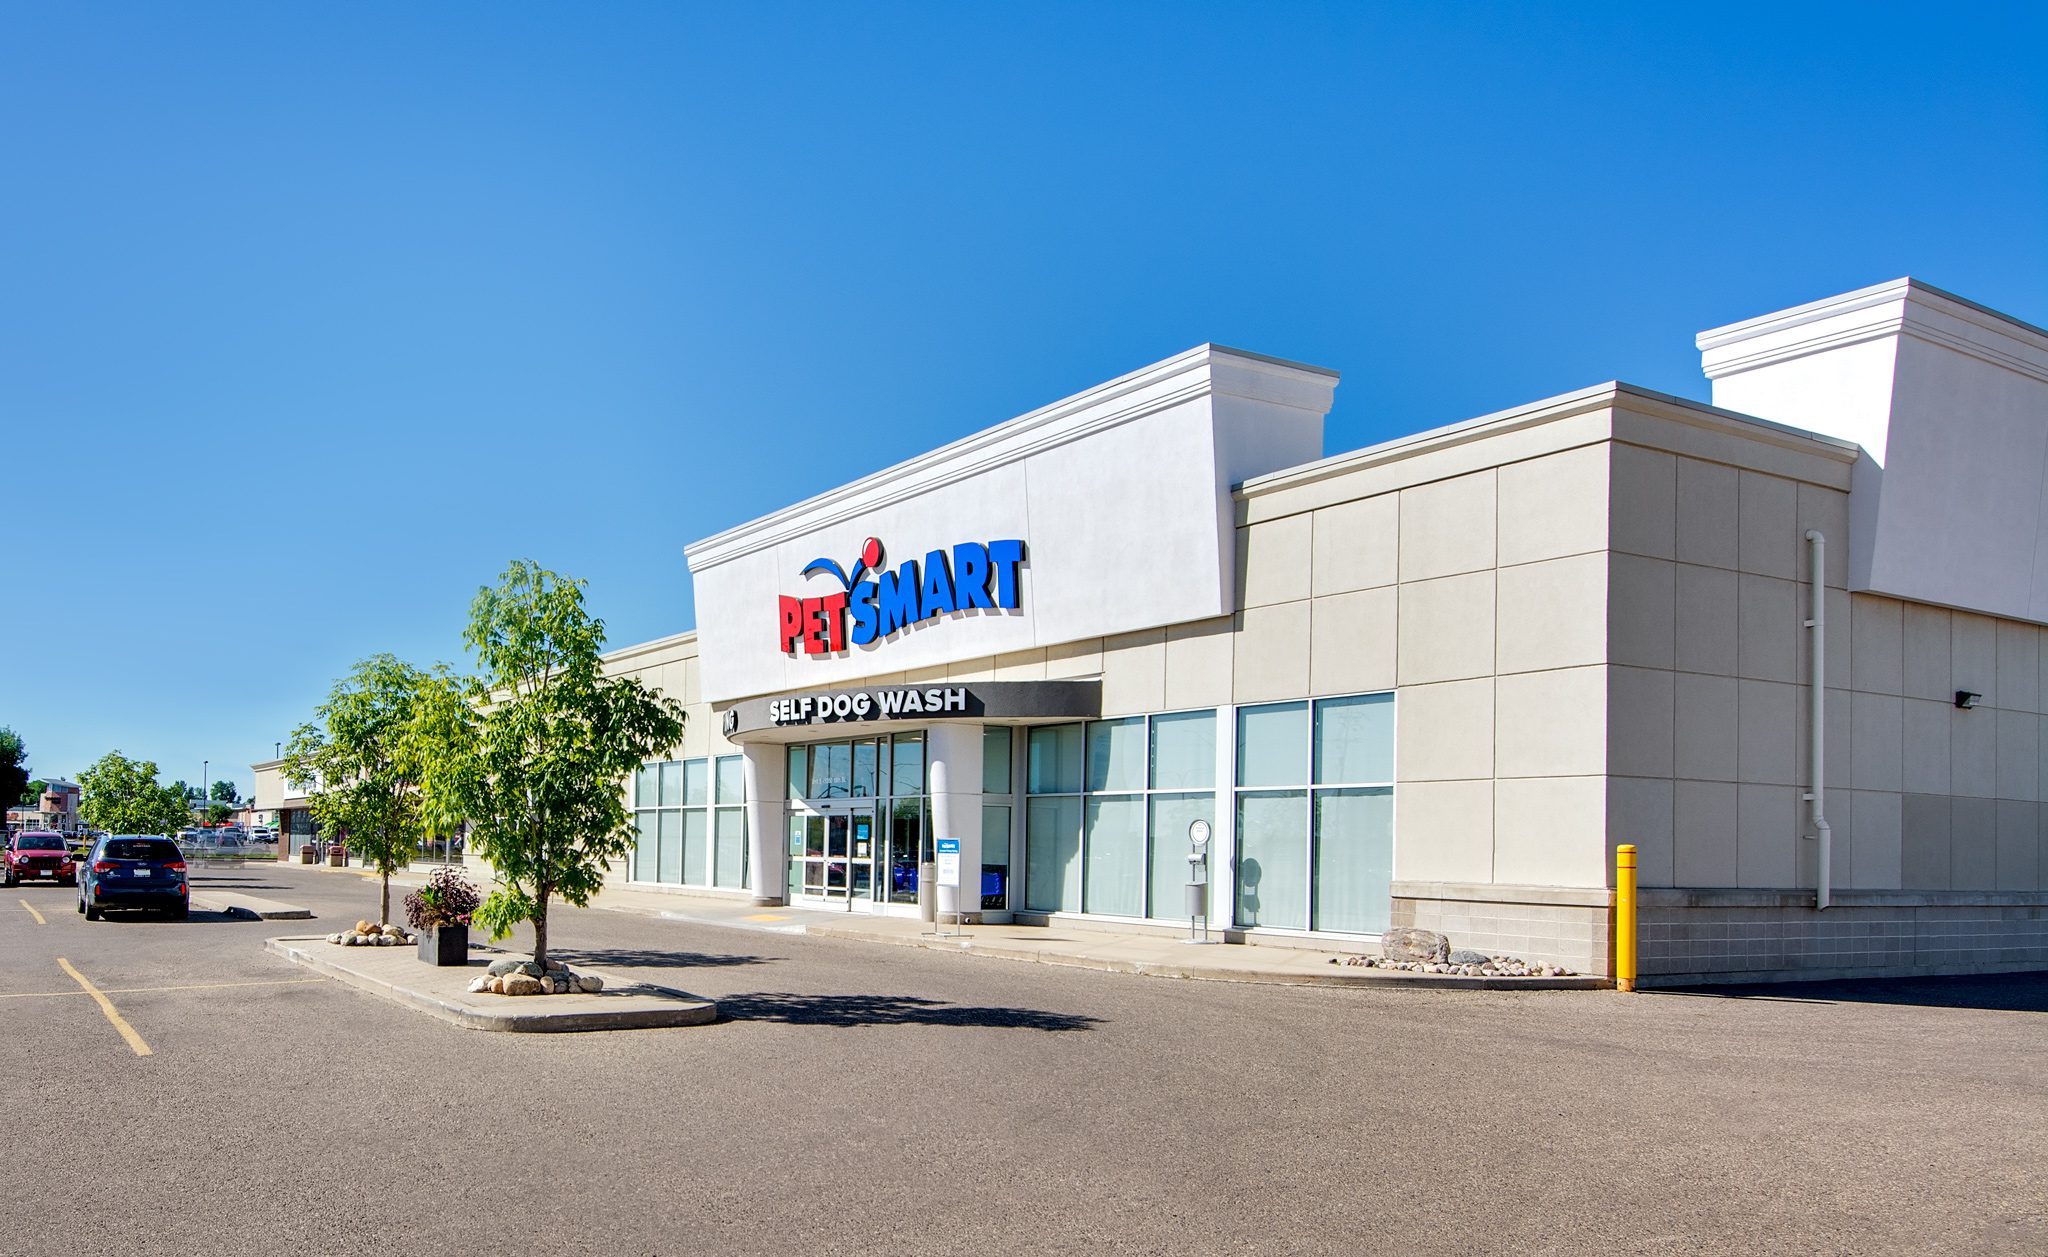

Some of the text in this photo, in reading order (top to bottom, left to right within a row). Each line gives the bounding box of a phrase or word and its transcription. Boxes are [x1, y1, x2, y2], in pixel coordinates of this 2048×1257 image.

[769, 687, 966, 722] SELF DOG WASH
